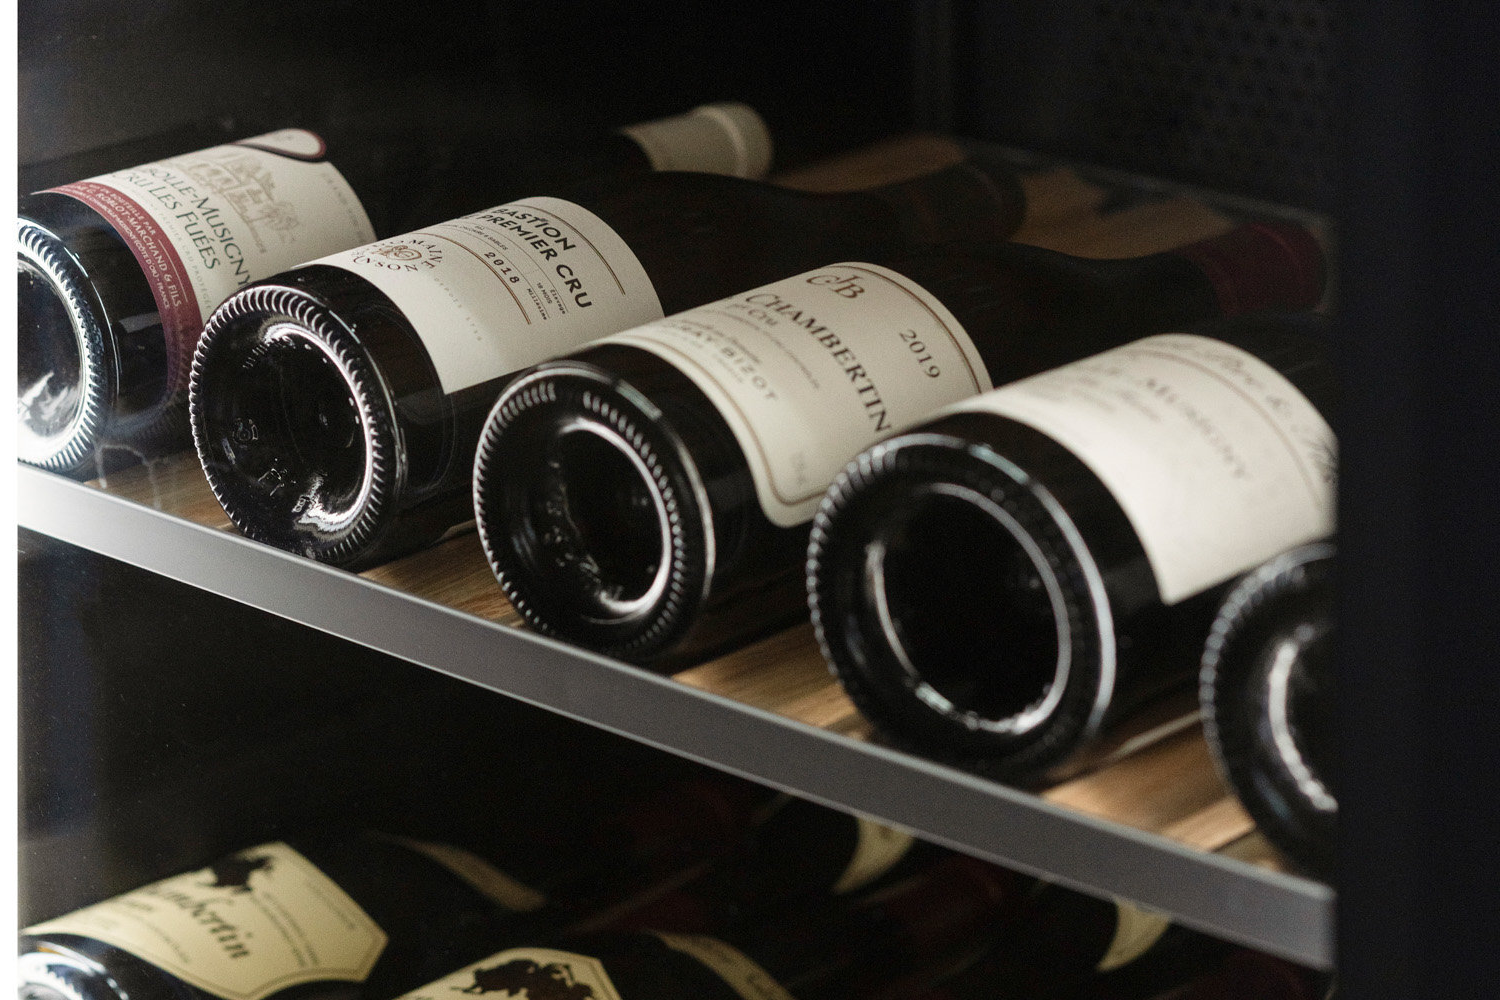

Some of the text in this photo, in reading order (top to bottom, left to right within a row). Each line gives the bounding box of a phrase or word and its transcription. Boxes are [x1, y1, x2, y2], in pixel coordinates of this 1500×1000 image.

[149, 185, 181, 210] LES
[176, 211, 221, 269] FUÉES
[491, 207, 577, 251] BASTION
[480, 214, 593, 309] PREMIER CRU
[483, 251, 521, 285] 2018
[168, 284, 183, 308] FILS
[746, 293, 893, 434] CHAMBERTIN
[898, 328, 941, 379] 2019
